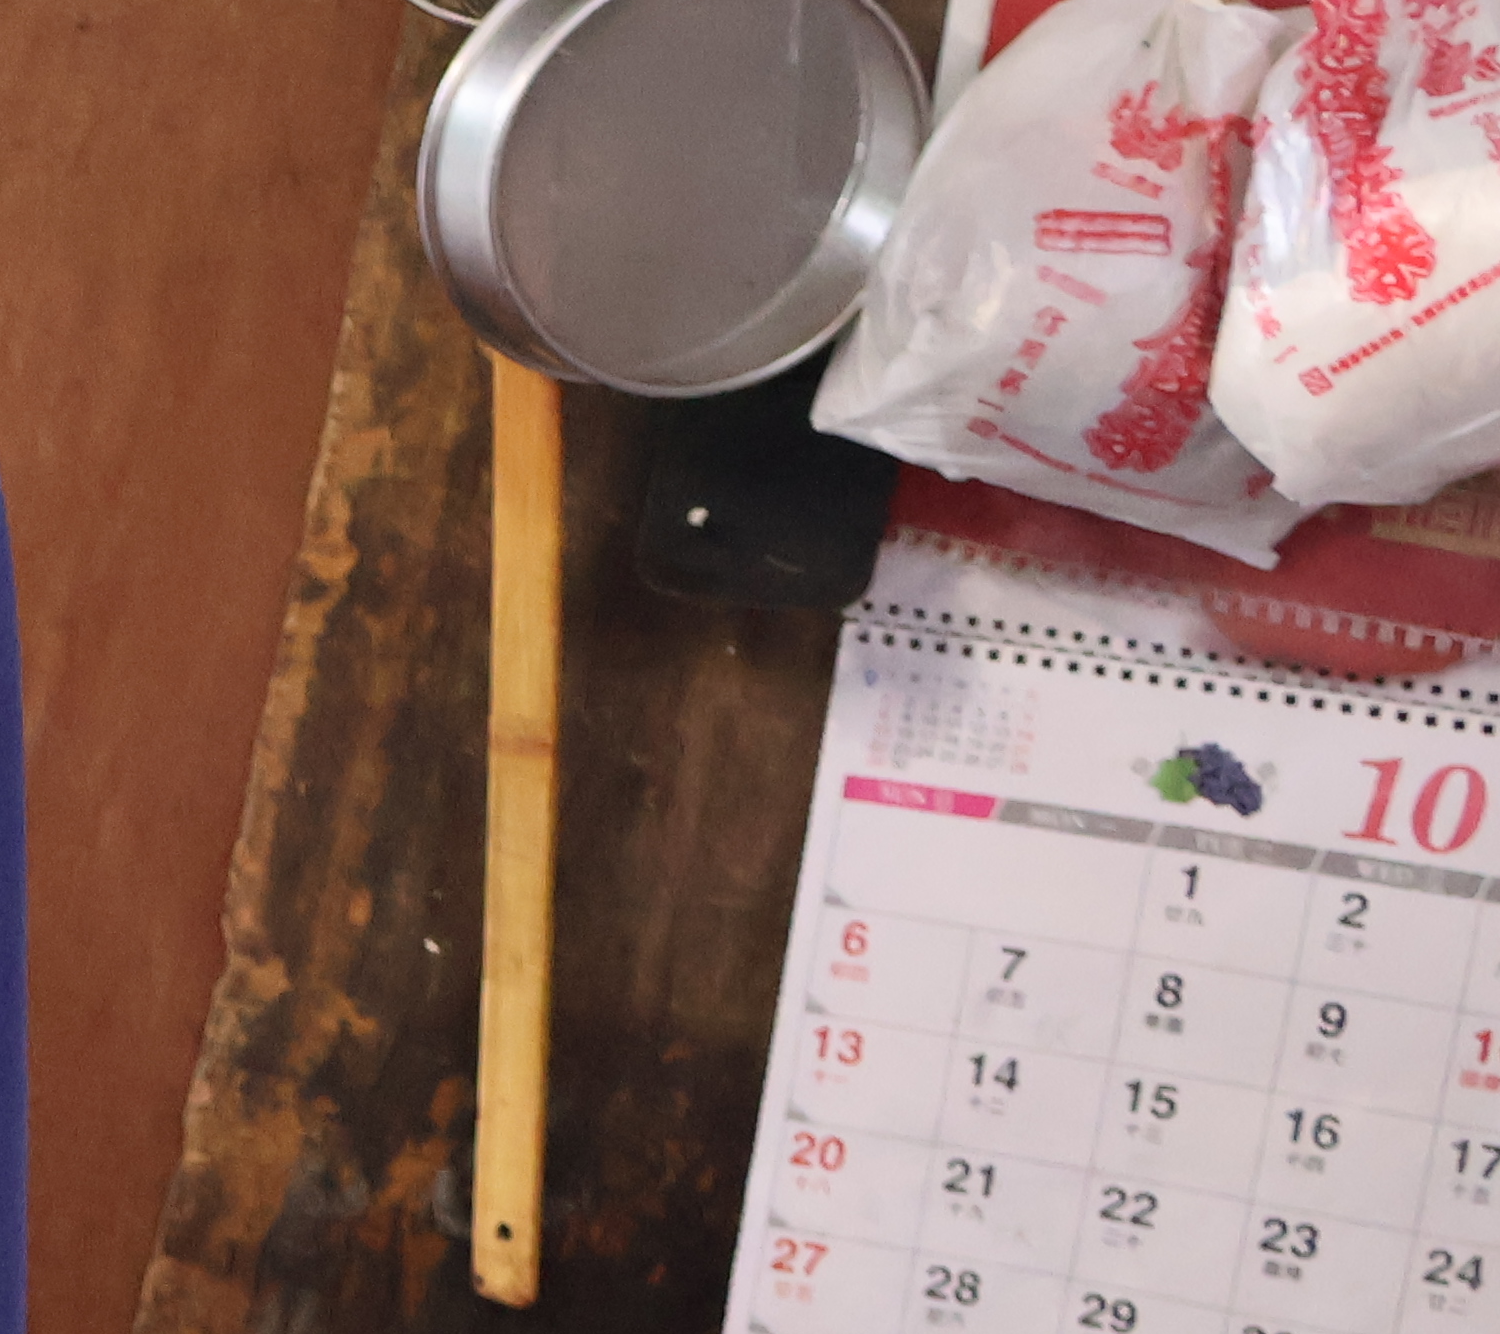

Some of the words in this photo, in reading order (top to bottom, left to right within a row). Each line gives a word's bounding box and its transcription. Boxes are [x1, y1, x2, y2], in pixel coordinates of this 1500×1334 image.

[1341, 756, 1487, 855] 10
[1181, 863, 1200, 900] 1
[1337, 892, 1370, 929] 2
[841, 920, 869, 956] 6
[1001, 946, 1029, 982] 7
[1155, 972, 1184, 1008] 8
[1317, 1001, 1348, 1038] 9
[1474, 1028, 1500, 1065] 1
[813, 1025, 866, 1066] 13
[969, 1051, 1020, 1093] 14
[1125, 1079, 1178, 1119] 15
[1285, 1106, 1342, 1151] 16
[1451, 1138, 1500, 1179] 17
[789, 1130, 847, 1173] 20
[942, 1157, 996, 1199] 21
[1099, 1185, 1160, 1230] 22
[1259, 1216, 1322, 1260] 23
[1423, 1248, 1484, 1292] 24
[771, 1237, 830, 1276] 27
[923, 1264, 983, 1308] 28
[1078, 1291, 1139, 1334] 29
